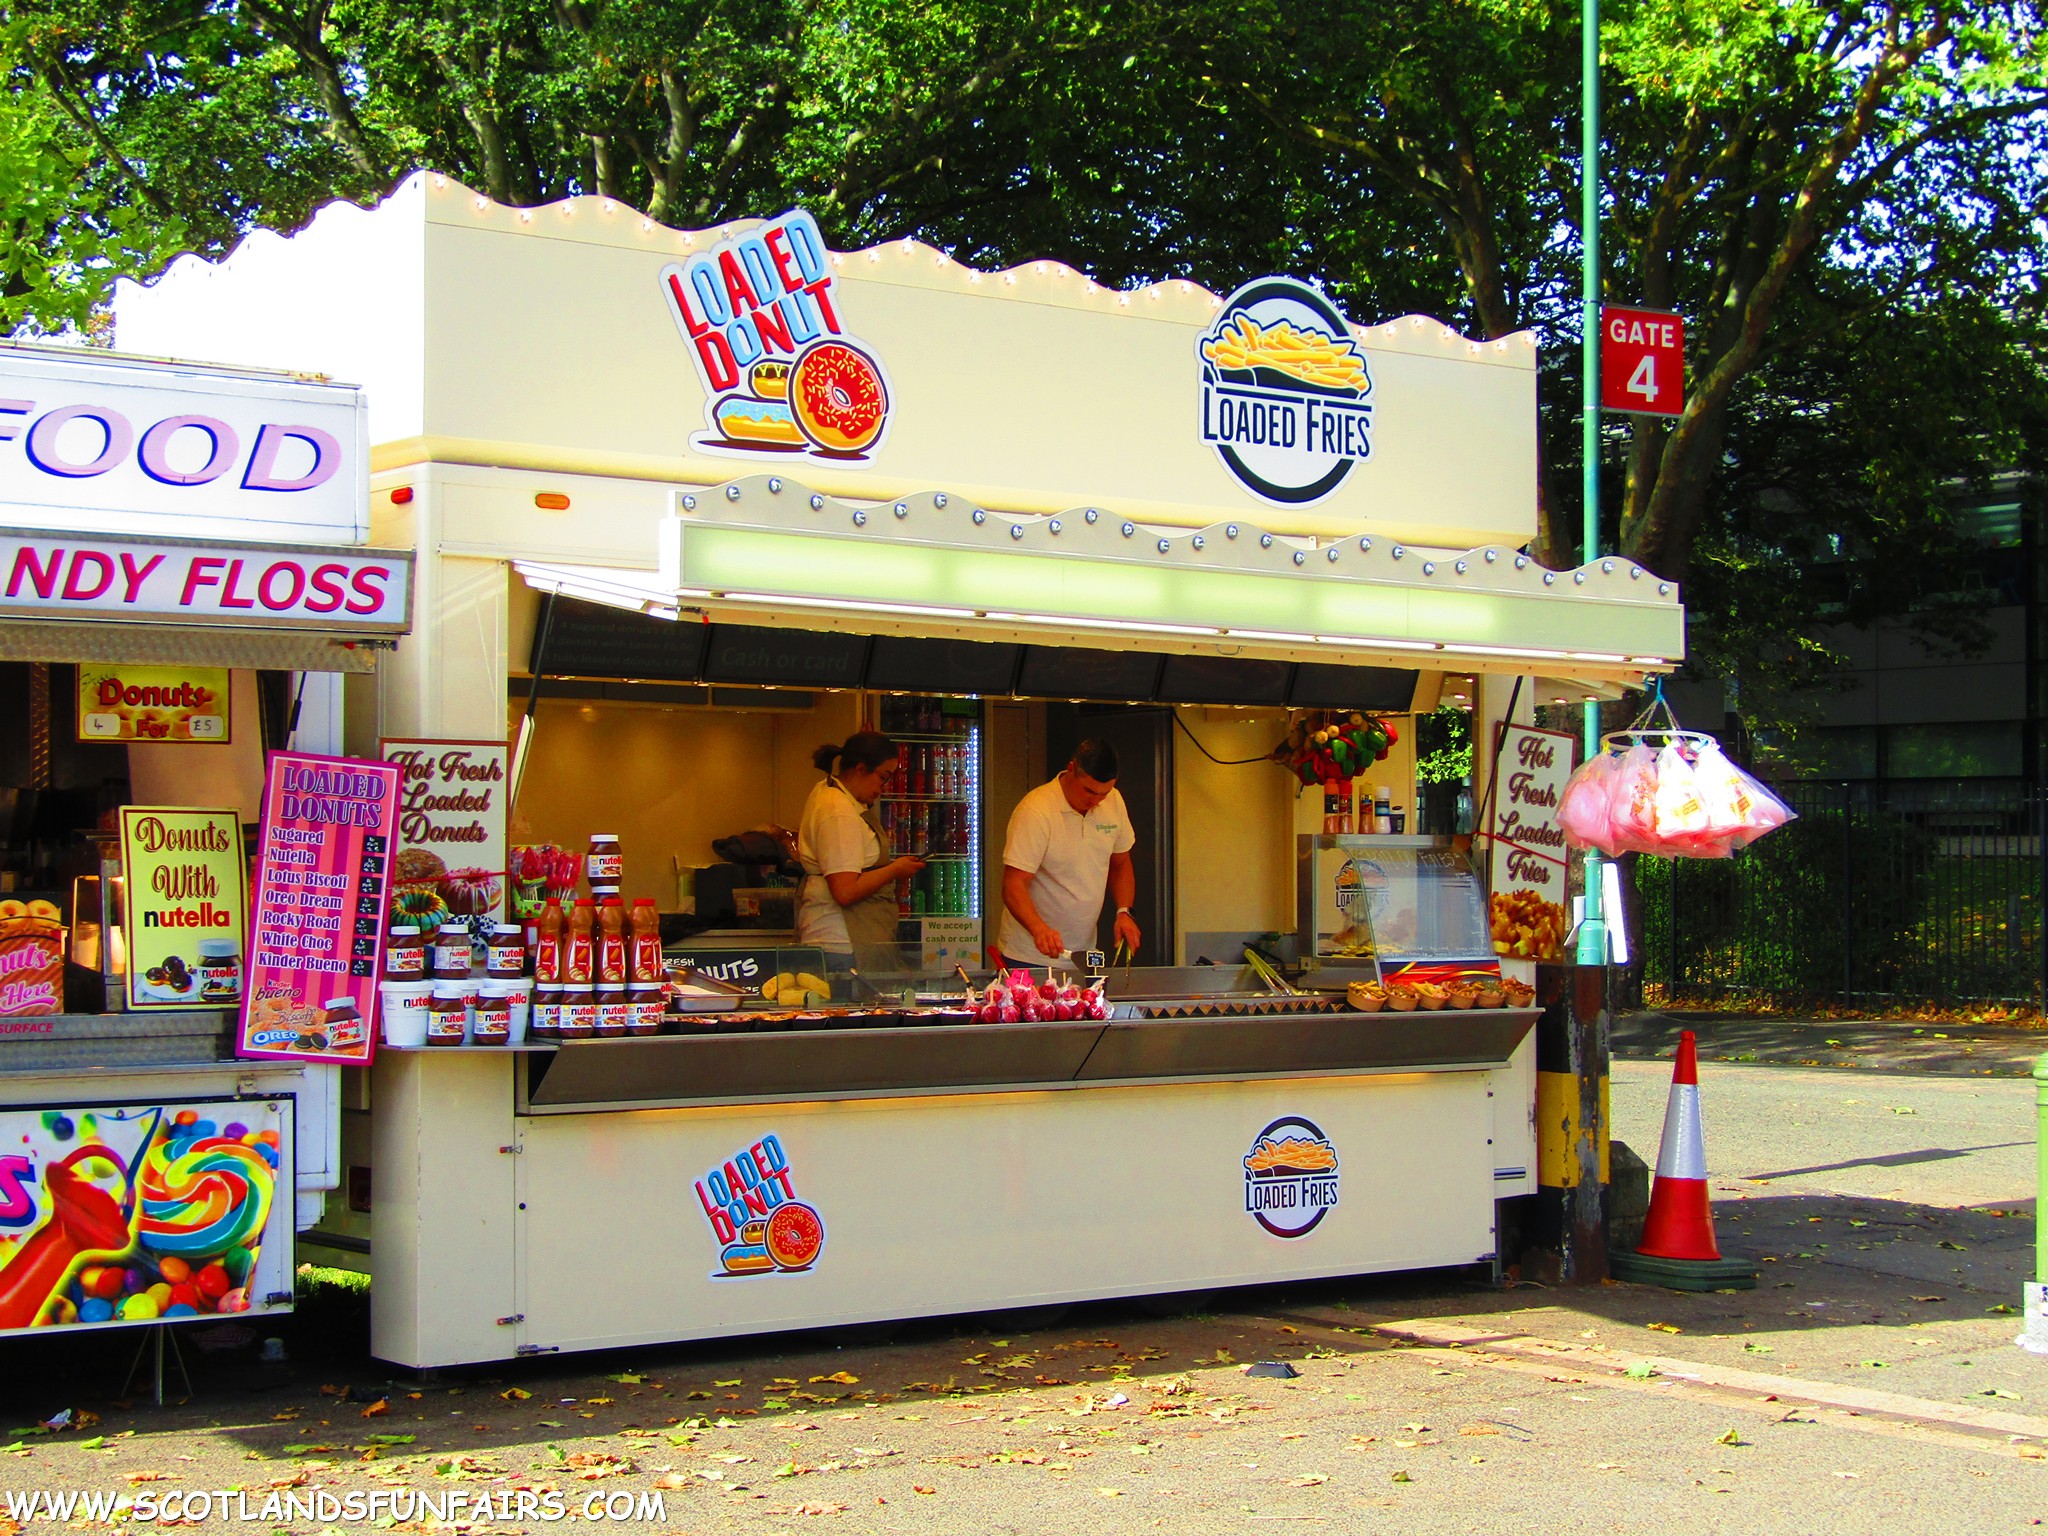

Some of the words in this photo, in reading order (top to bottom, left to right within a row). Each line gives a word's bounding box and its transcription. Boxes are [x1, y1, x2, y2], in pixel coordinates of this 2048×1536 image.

[668, 218, 825, 339] LOADED
[693, 277, 841, 392] DONUT
[1610, 319, 1674, 348] GATE
[1627, 355, 1658, 402] 4
[1203, 386, 1296, 448] LOADED
[1307, 398, 1370, 458] FRIES
[179, 556, 390, 615] FLOSS
[721, 646, 770, 667] Cash
[776, 653, 799, 668] or
[805, 652, 849, 672] card
[99, 677, 206, 708] Donuts
[136, 718, 169, 738] For
[389, 750, 435, 782] Hot
[439, 750, 504, 783] Fresh
[1518, 735, 1554, 770] Hot
[281, 766, 387, 801] LOADED
[401, 781, 491, 813] Loaded
[1508, 771, 1557, 808] Fresh
[280, 794, 382, 828] DONUTS
[135, 816, 231, 853] Donuts
[272, 827, 325, 845] Sugared
[401, 812, 488, 845] Donuts
[1495, 810, 1565, 848] Loaded
[269, 847, 316, 865] Nutella
[1507, 849, 1551, 885] Fries
[152, 864, 220, 901] With
[267, 869, 301, 884] Lotus
[305, 873, 348, 889] Biscoff
[265, 890, 296, 905] Oreo
[300, 892, 343, 909] Dream
[144, 902, 230, 927] nutella
[263, 911, 303, 928] Rocky
[306, 914, 340, 930] Road
[928, 921, 941, 930] We
[944, 922, 973, 931] accept
[262, 931, 301, 946] White
[301, 935, 332, 950] Choc
[925, 934, 946, 943] cash
[958, 934, 978, 943] card
[202, 966, 238, 978] nutella
[258, 952, 302, 968] Kinder
[306, 955, 347, 972] Bueno
[4, 981, 54, 1006] Here
[256, 987, 301, 1001] bueno
[267, 979, 291, 988] kinder
[0, 1022, 54, 1034] SURFACE
[276, 1007, 317, 1024] Biscoff
[329, 1019, 359, 1032] nutella
[253, 1030, 298, 1044] OREO
[694, 1134, 786, 1217] LOADED
[709, 1166, 795, 1245] DONUT
[1246, 1182, 1297, 1211] LOADED
[1302, 1177, 1338, 1208] FRIES
